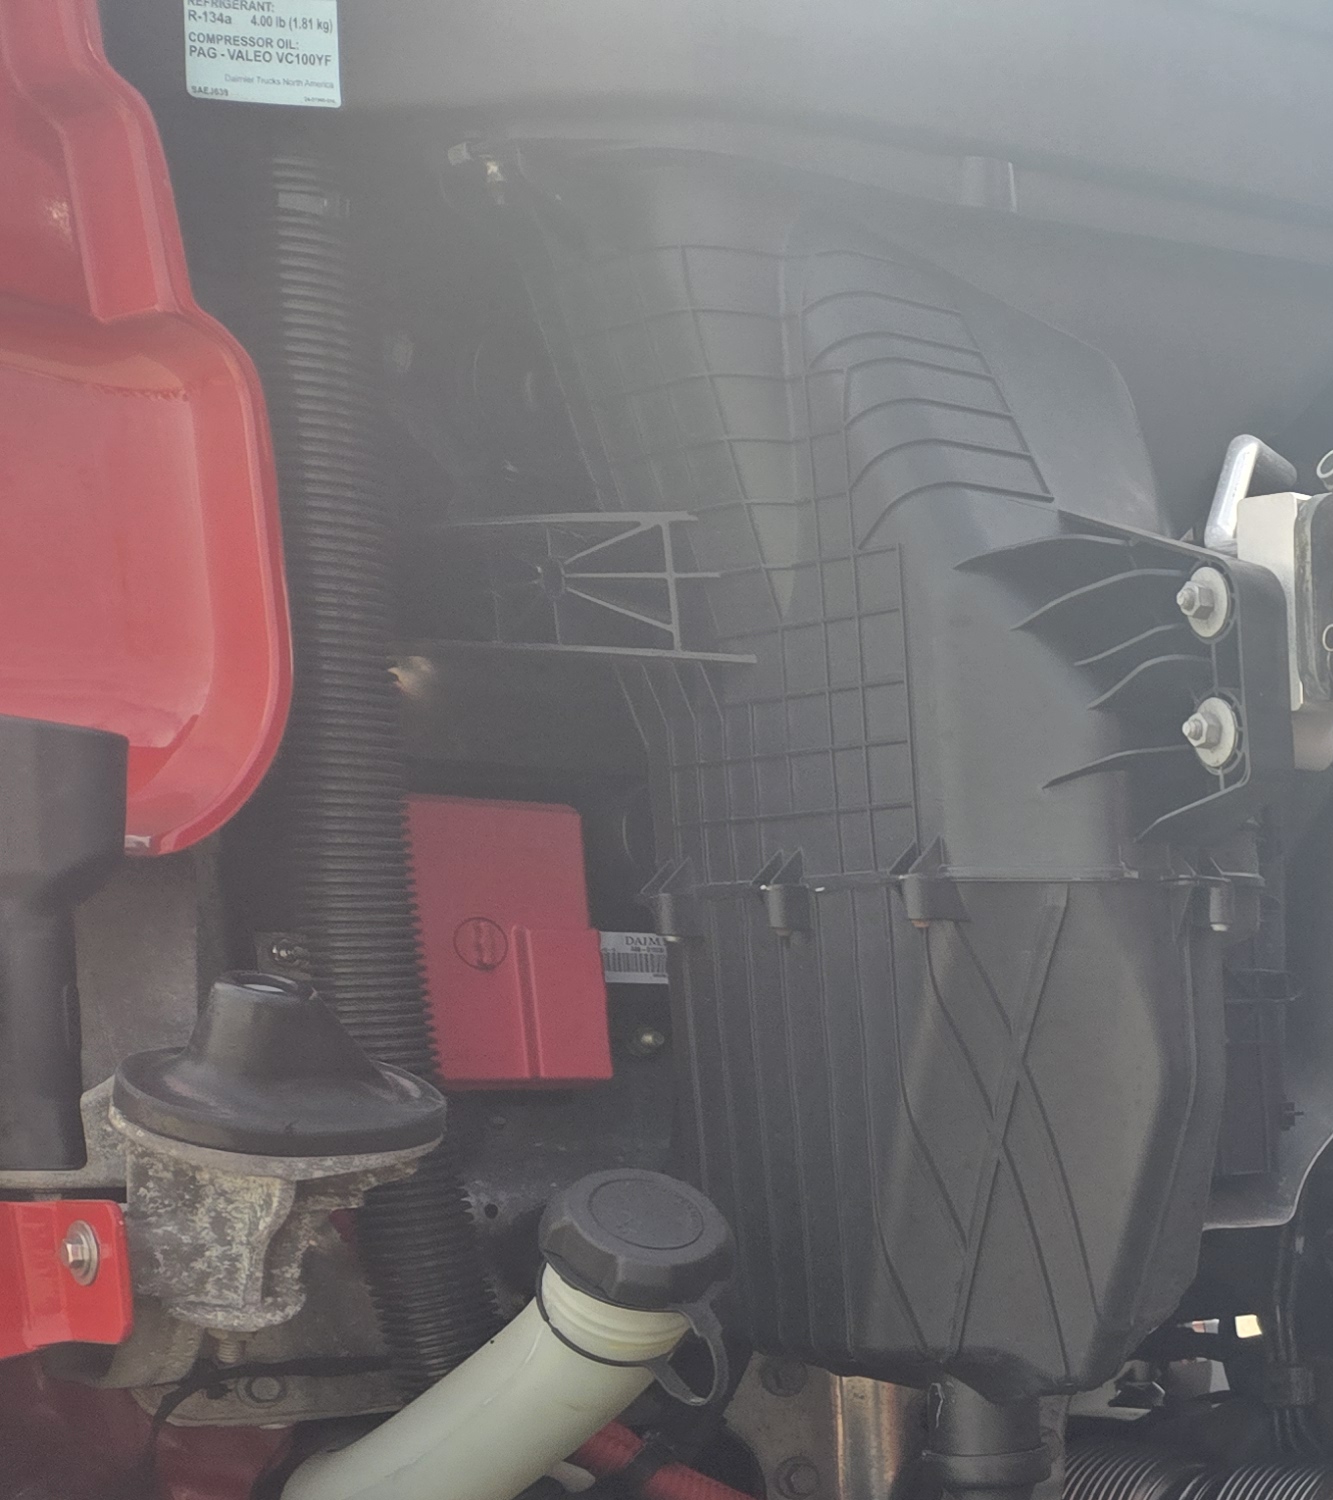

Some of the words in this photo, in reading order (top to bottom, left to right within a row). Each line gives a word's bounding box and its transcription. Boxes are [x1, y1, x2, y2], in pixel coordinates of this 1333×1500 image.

[187, 0, 275, 12] REFRIGERANT:
[188, 10, 232, 25] R-134a
[251, 15, 273, 27] 4.00
[275, 16, 286, 28] lb
[289, 17, 313, 32] (1.81
[316, 18, 333, 34] kg)
[188, 32, 274, 49] COMPRESSOR
[277, 38, 300, 50] OIL:
[189, 45, 217, 59] PAG
[227, 48, 272, 63] VALEO
[276, 52, 332, 66] VC100YF
[224, 74, 254, 84] Daimler
[256, 75, 281, 86] Trucks
[283, 77, 303, 88] North
[304, 78, 335, 90] America
[625, 936, 662, 946] DAIM
